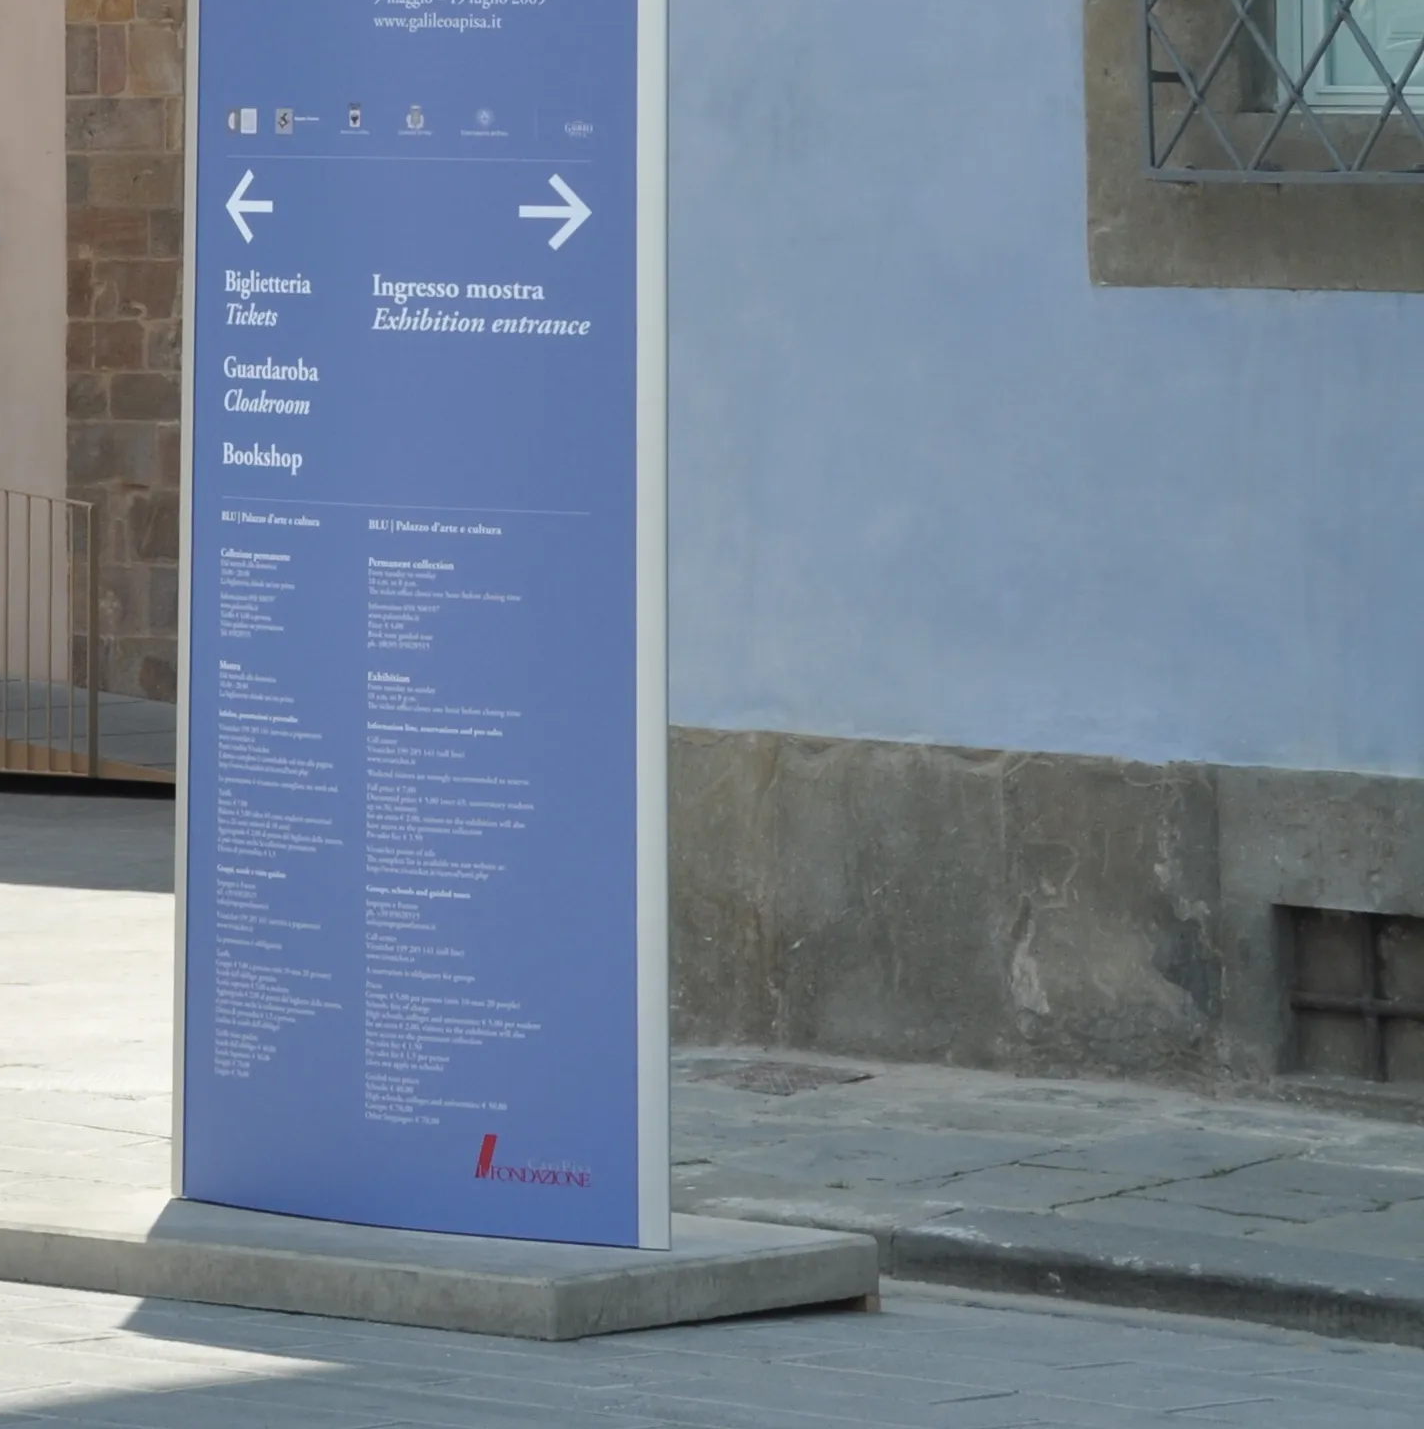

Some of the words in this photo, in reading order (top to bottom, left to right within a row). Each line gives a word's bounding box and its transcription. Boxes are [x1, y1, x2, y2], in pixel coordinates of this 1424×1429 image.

[374, 13, 502, 32] www.galileoapisa.it
[224, 270, 312, 300] Biglietteria
[372, 273, 460, 304] Ingresso
[466, 280, 545, 301] mostra
[226, 302, 278, 327] Tickets
[371, 308, 485, 333] Exhibition
[492, 315, 591, 336] entrance
[224, 356, 319, 383] Guardaroba
[223, 389, 310, 416] Cloakroom
[222, 442, 303, 475] Bookshop
[368, 519, 388, 530] BLU
[396, 520, 428, 532] Palazzo
[468, 524, 502, 535] cultura
